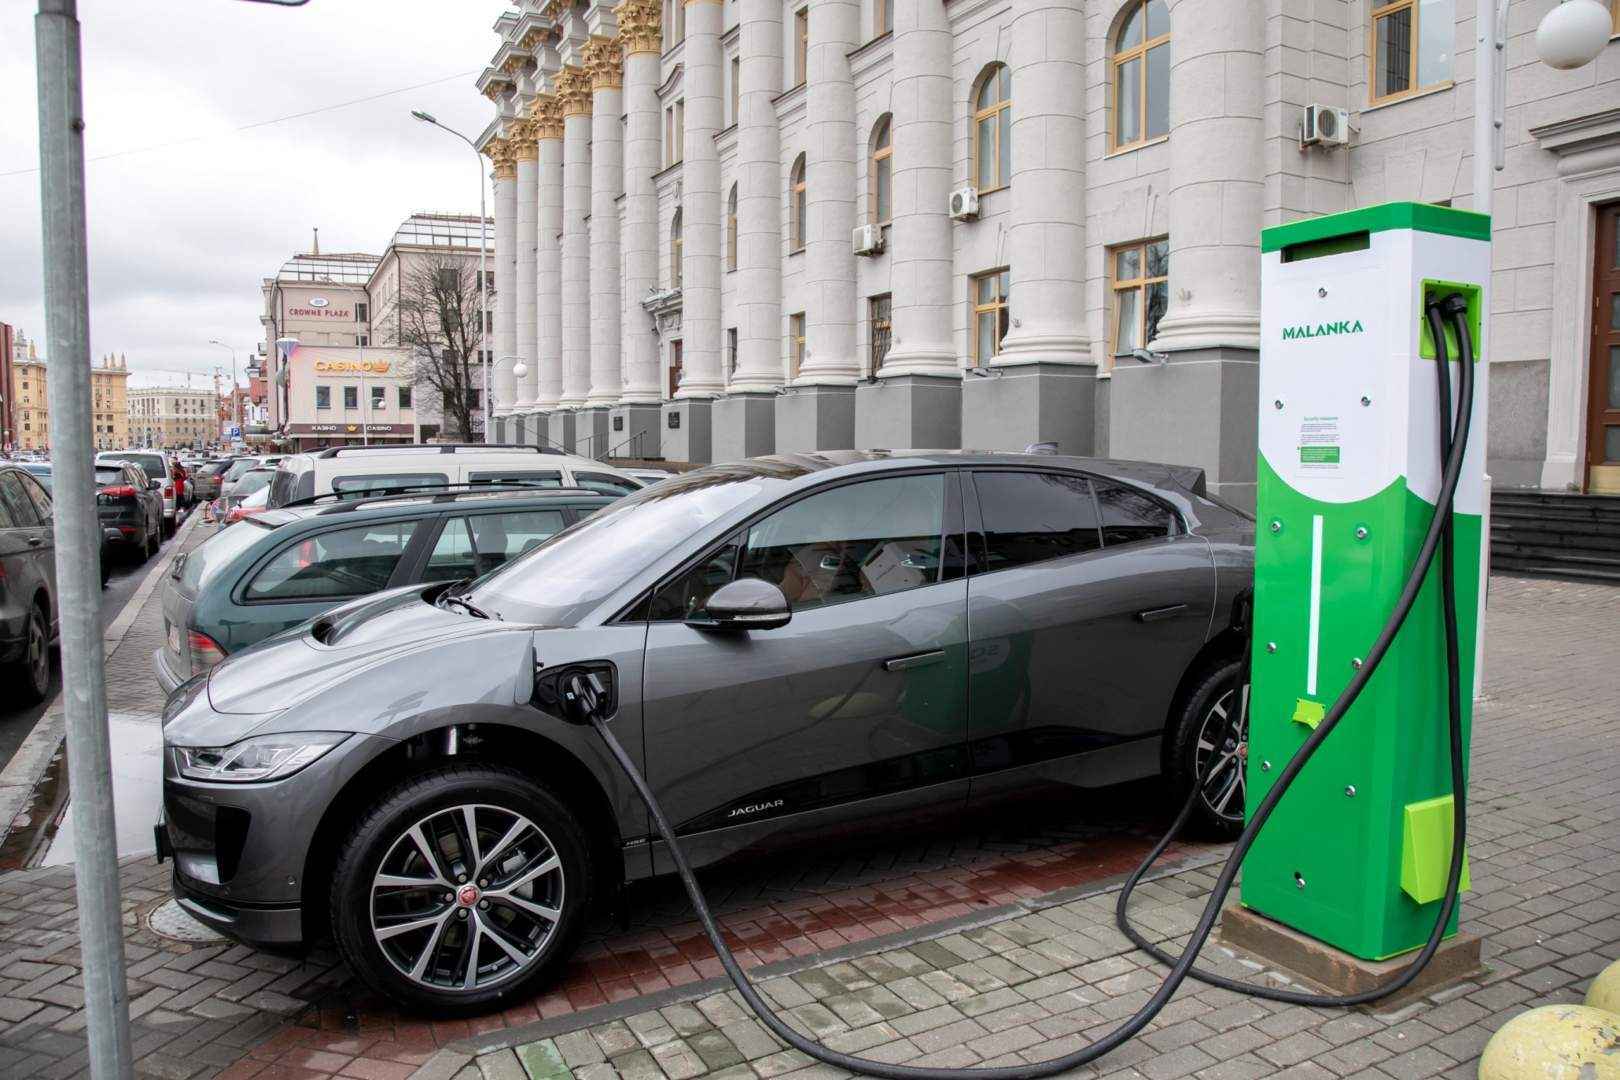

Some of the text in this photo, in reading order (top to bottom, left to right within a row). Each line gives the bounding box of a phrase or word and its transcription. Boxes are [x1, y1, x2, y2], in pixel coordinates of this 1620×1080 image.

[289, 308, 350, 317] CROWNE PLAZA
[1283, 320, 1363, 340] MALANKA
[315, 361, 373, 372] CASINO
[728, 800, 784, 817] JAGUAR
